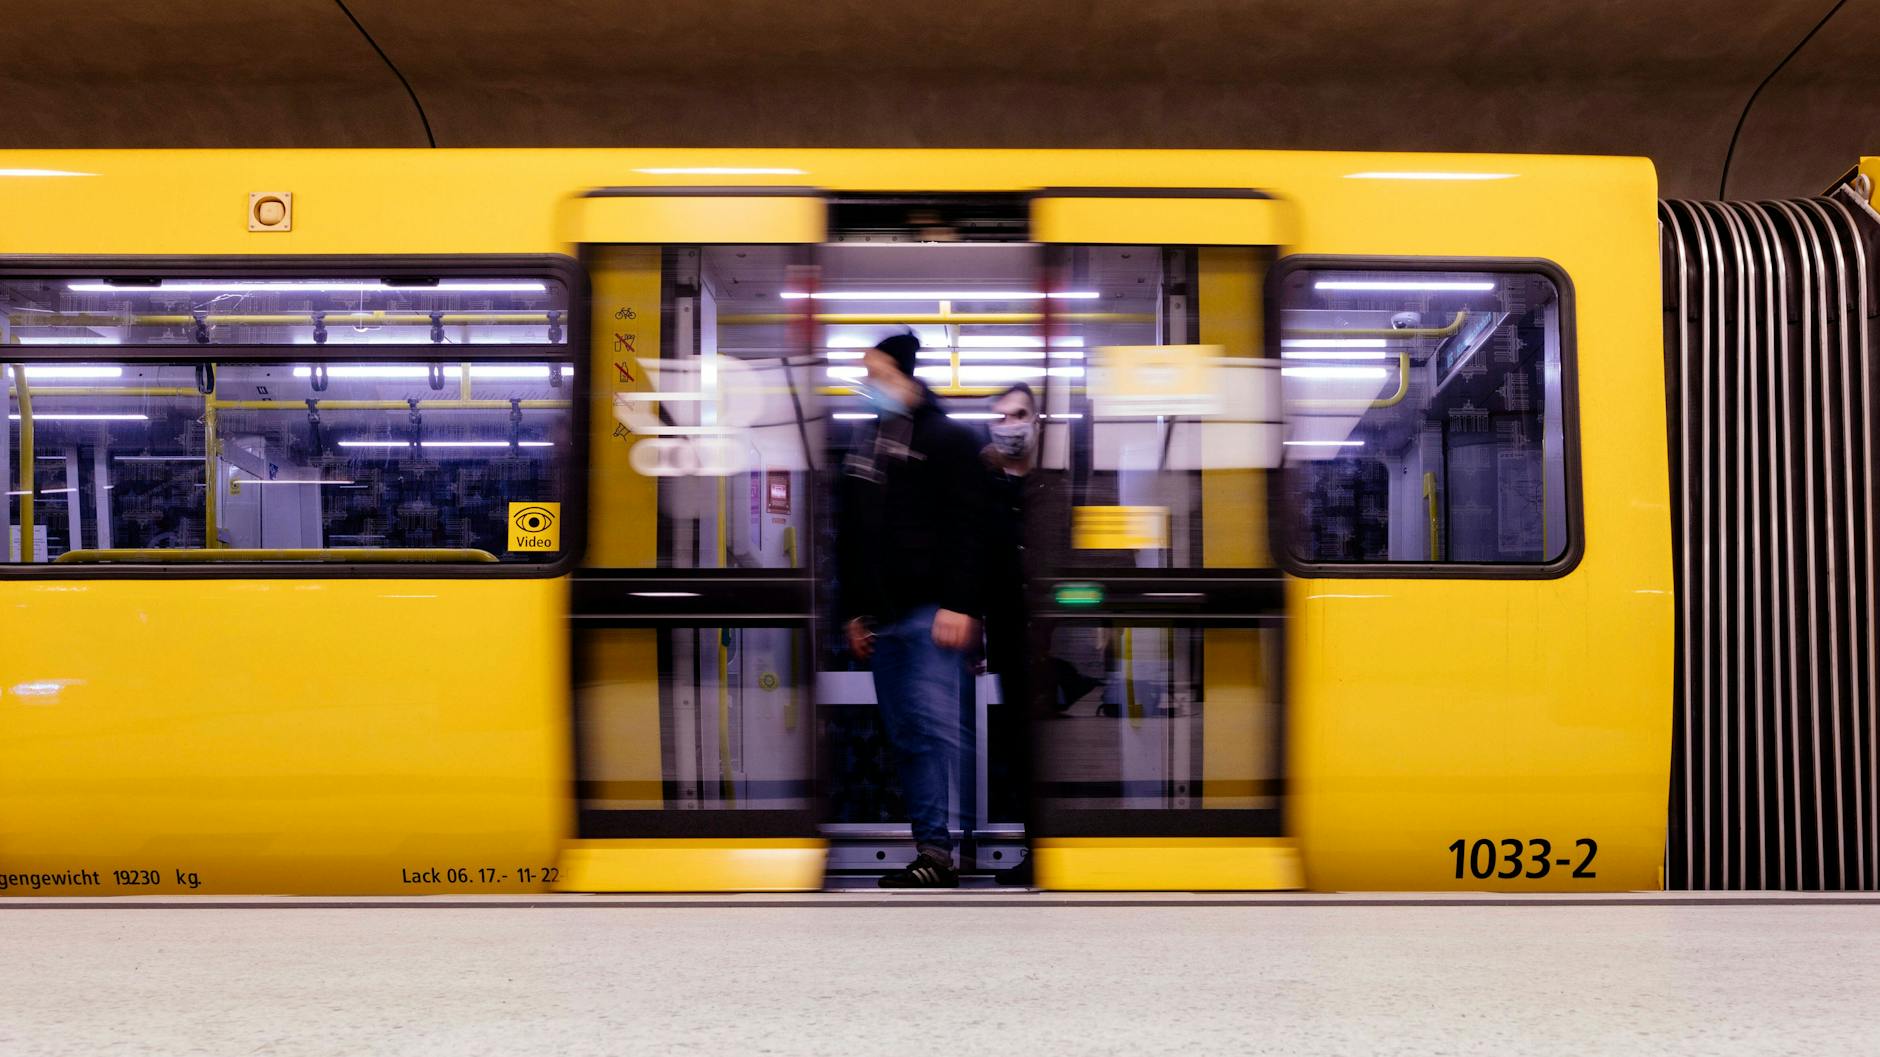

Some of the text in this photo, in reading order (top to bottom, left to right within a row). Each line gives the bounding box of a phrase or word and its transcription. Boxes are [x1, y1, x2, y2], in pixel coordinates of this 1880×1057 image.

[516, 536, 552, 548] Video
[1449, 838, 1598, 879] 1033-2
[0, 869, 202, 889] gengewicht 19230 kg.
[402, 867, 441, 884] Lack
